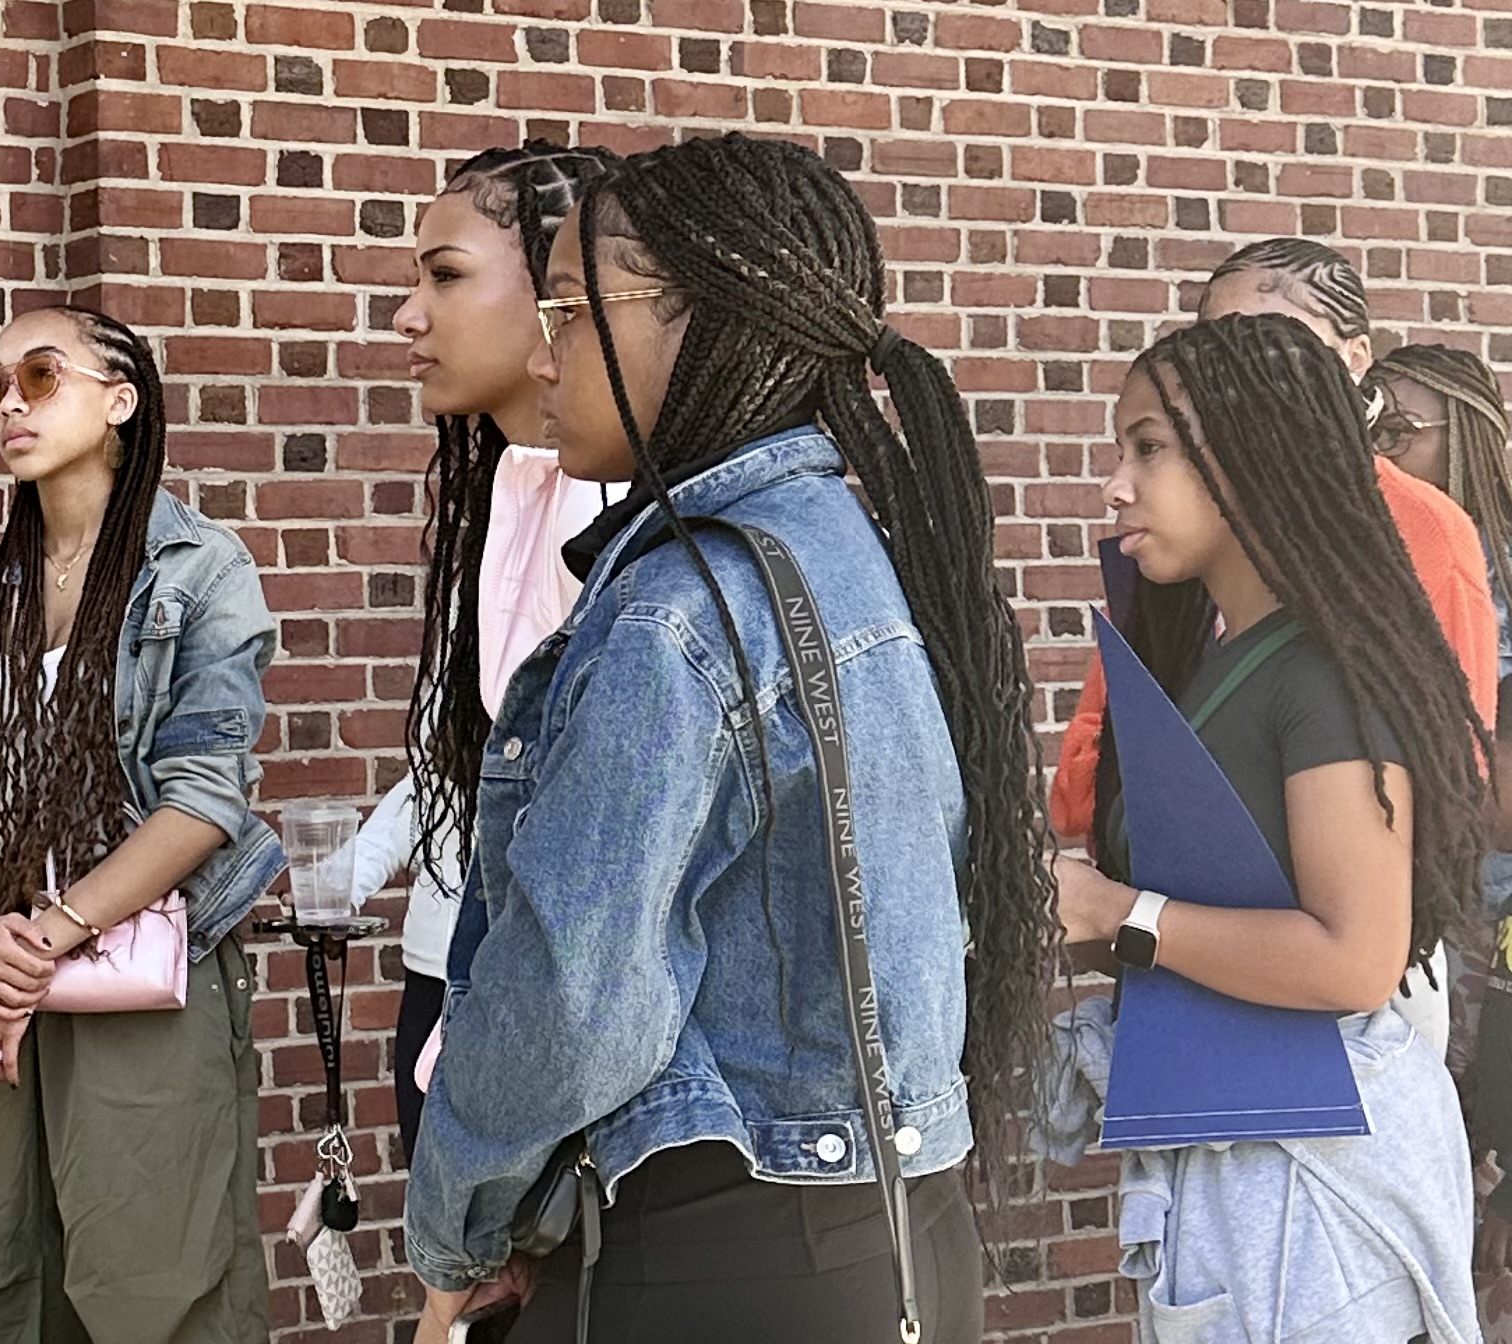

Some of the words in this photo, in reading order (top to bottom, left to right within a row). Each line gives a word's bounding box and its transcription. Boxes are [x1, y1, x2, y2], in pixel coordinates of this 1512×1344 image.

[757, 535, 786, 560] ST
[786, 597, 823, 663] NINE
[808, 669, 840, 746] WEST
[833, 787, 858, 859] NINE
[845, 865, 868, 946] WEST
[311, 945, 335, 1068] lululemo
[858, 986, 886, 1058] NINE
[872, 1064, 895, 1142] WEST
